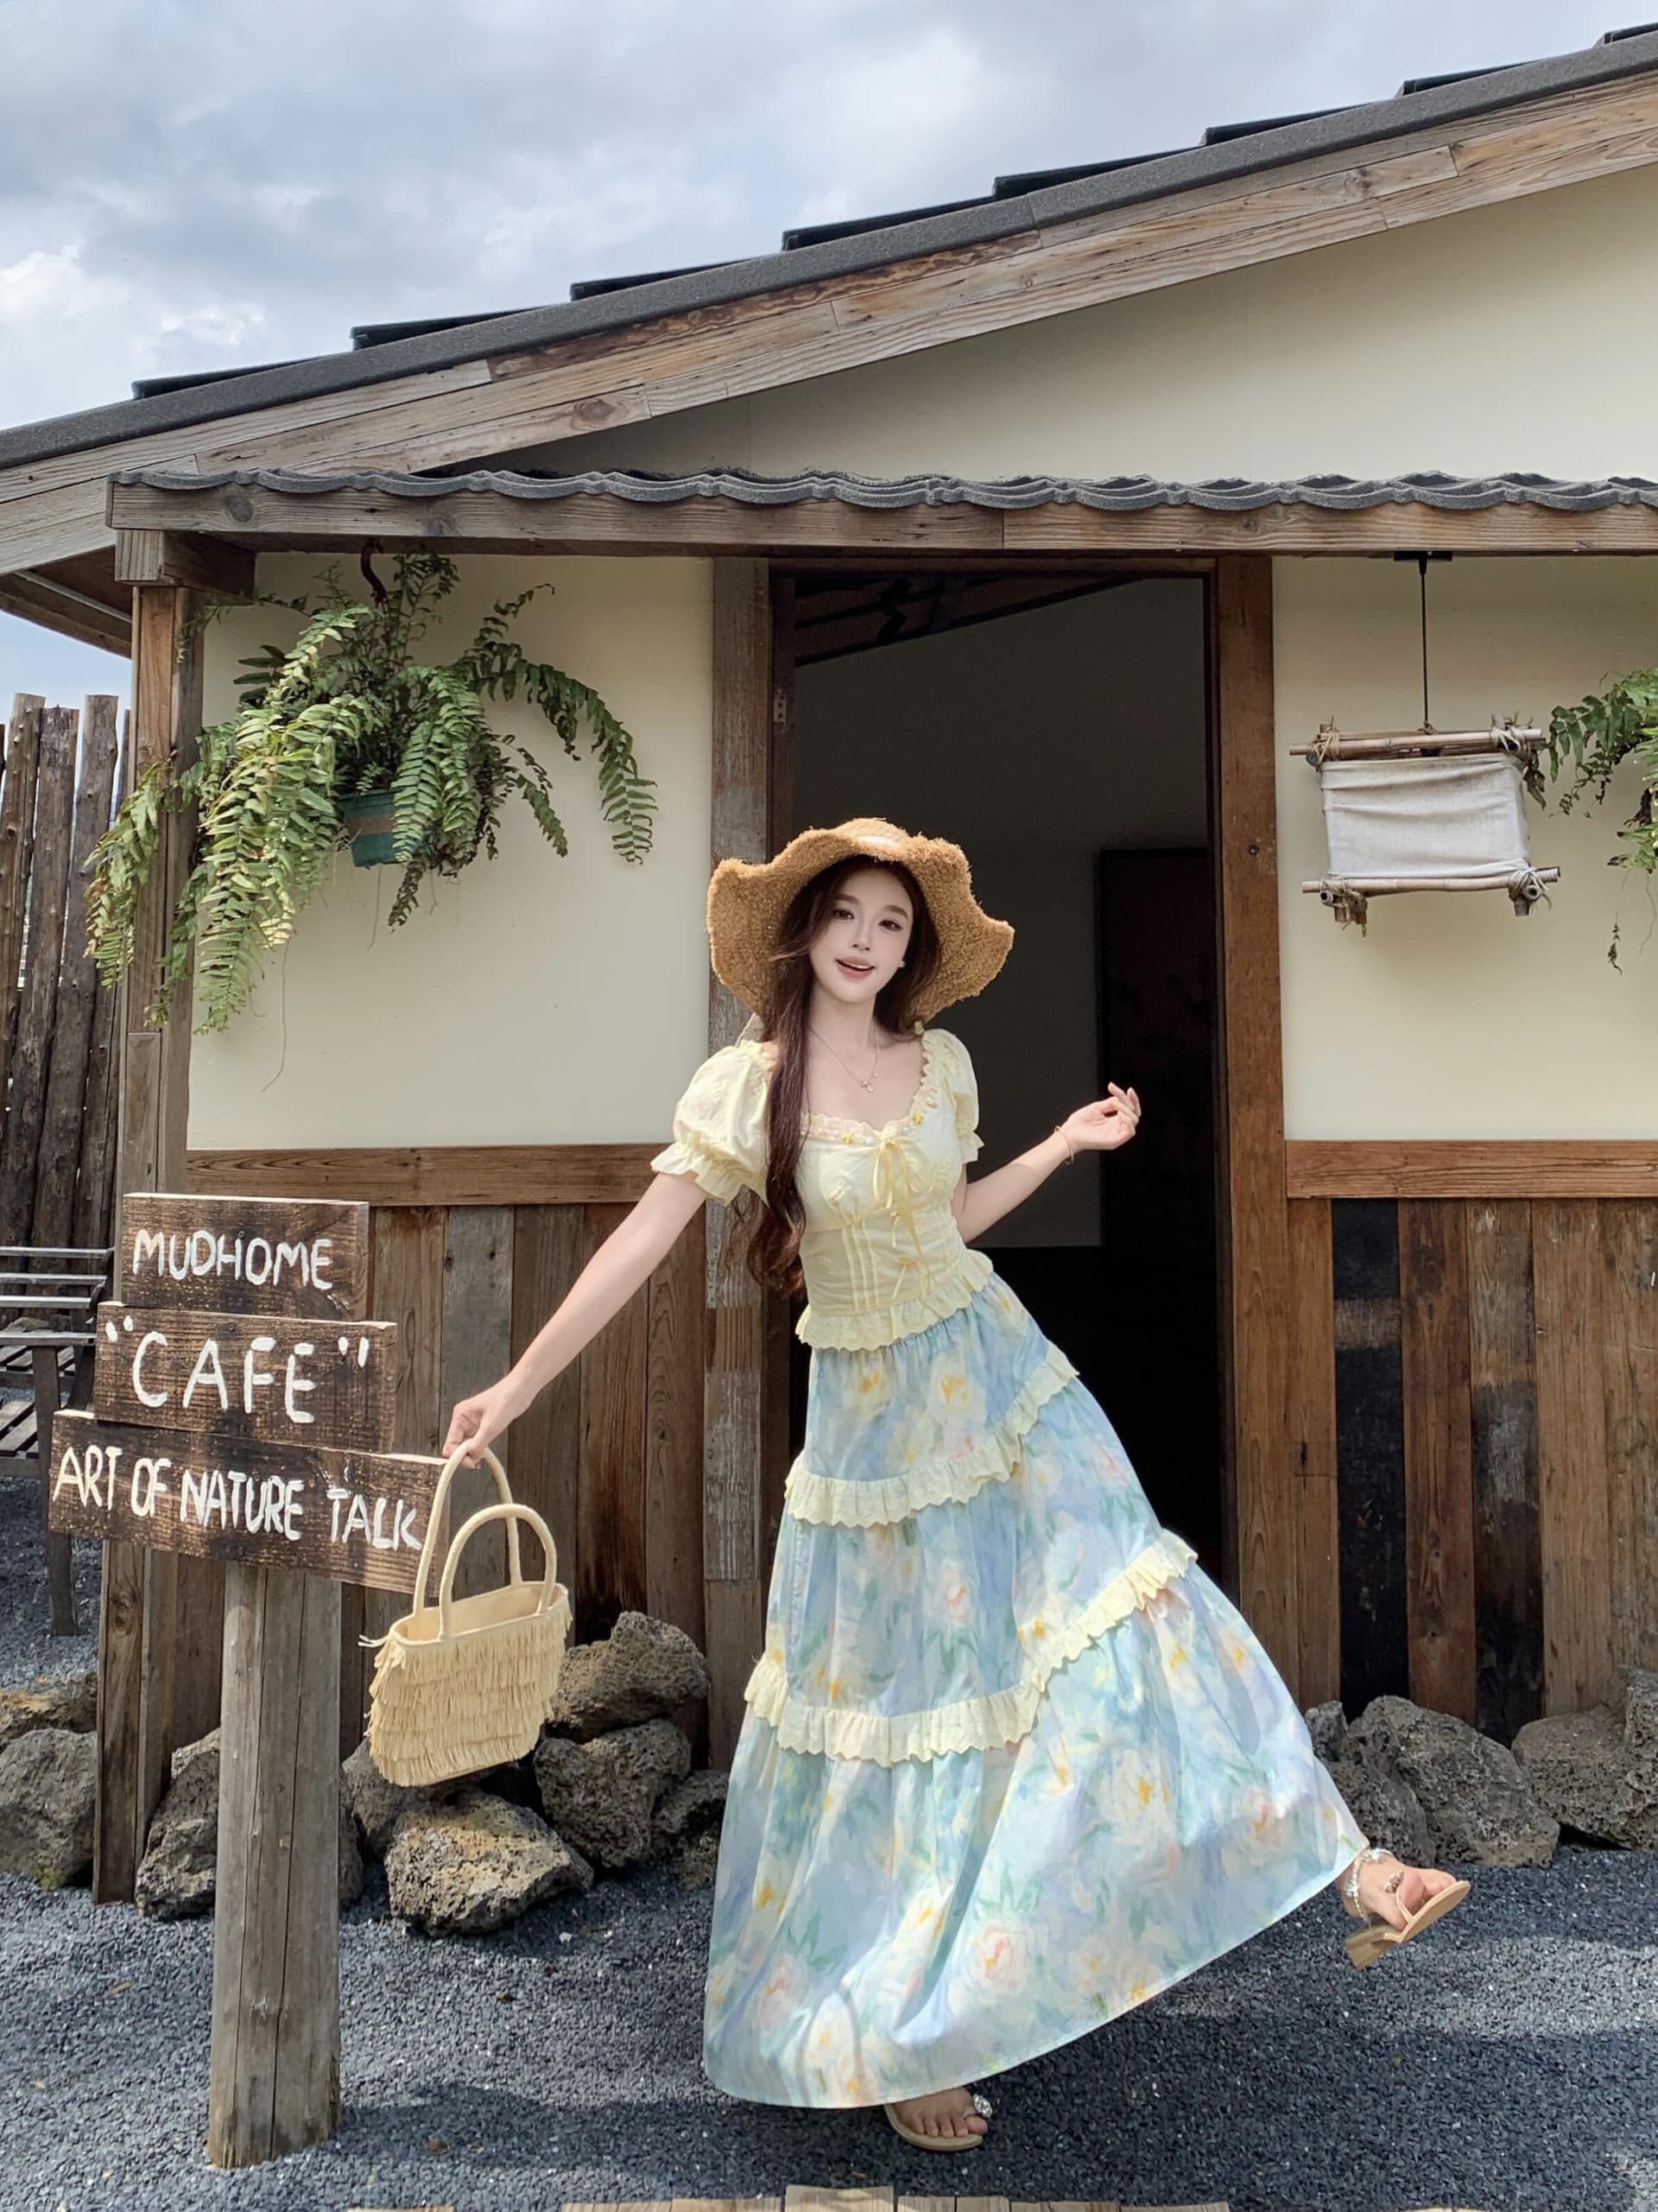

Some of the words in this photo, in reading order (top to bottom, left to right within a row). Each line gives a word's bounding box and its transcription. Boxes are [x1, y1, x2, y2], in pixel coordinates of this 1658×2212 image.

[133, 1229, 333, 1290] MUDHOME
[53, 1445, 123, 1511] ART
[130, 1458, 171, 1517] OF
[180, 1469, 305, 1541] NATURE
[326, 1487, 422, 1551] TALK
